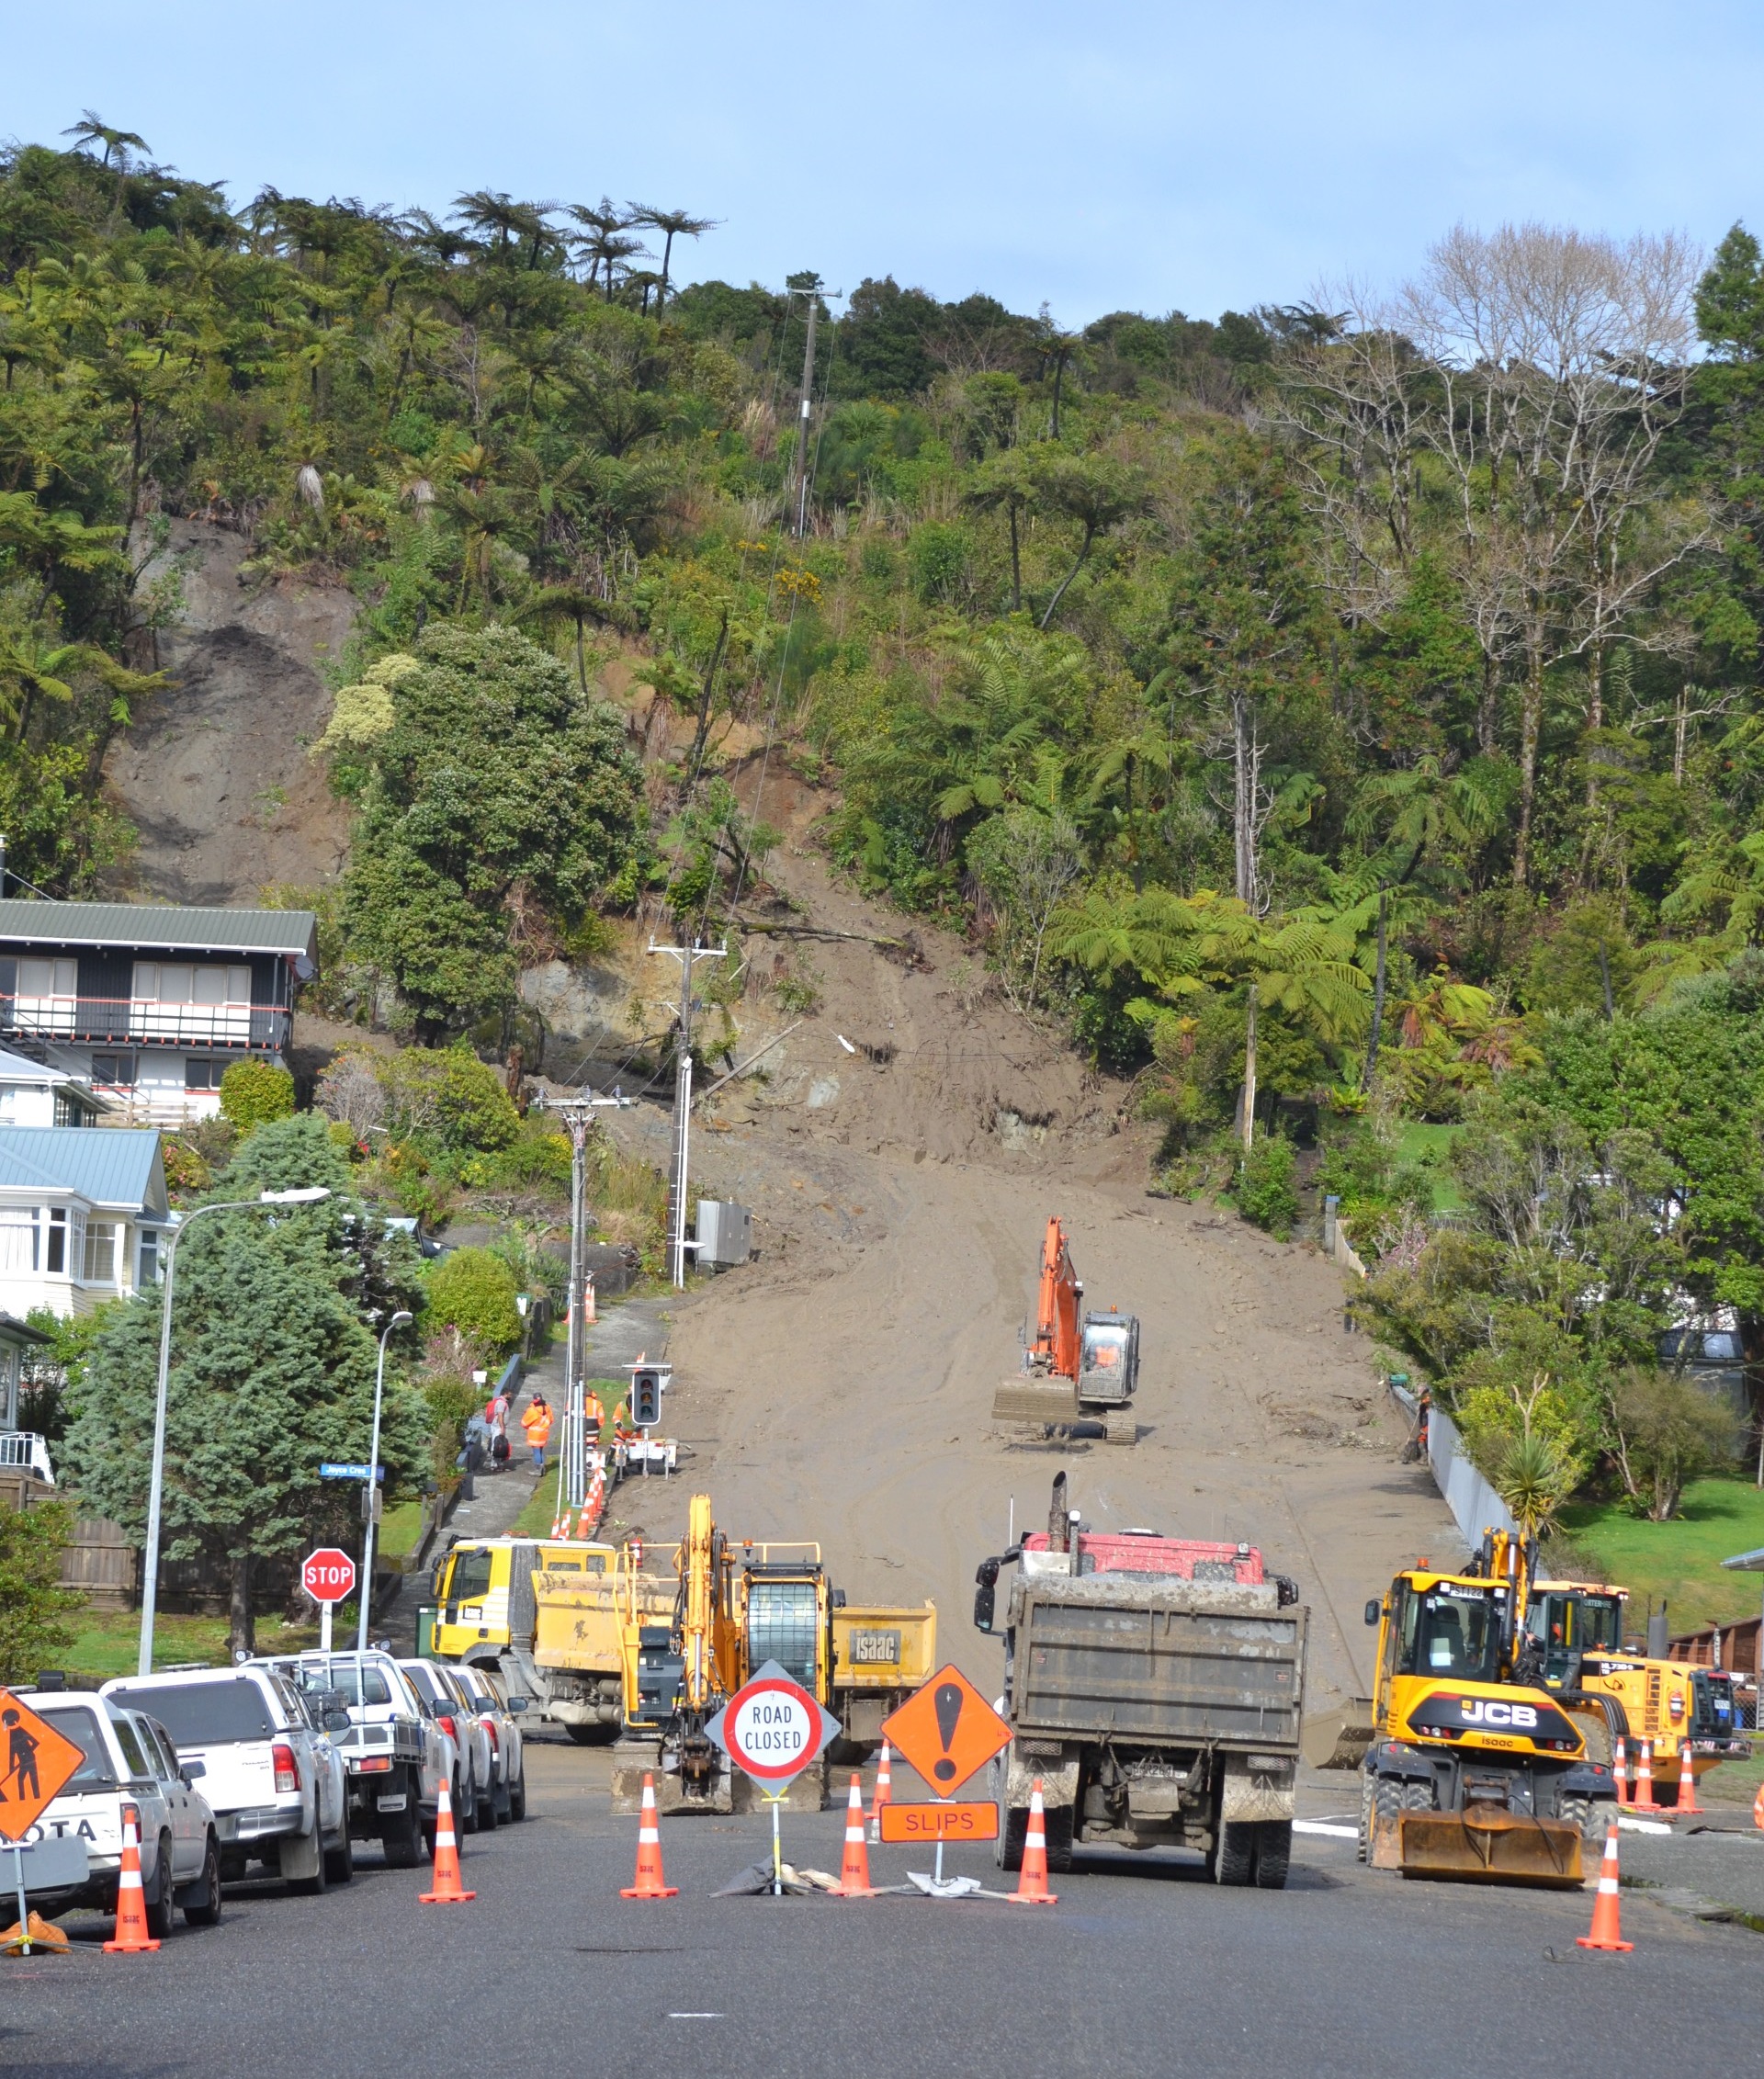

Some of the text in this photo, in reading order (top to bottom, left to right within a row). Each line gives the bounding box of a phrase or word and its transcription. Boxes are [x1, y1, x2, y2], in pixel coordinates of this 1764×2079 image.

[306, 1566, 352, 1585] STOP
[855, 1630, 895, 1660] isaac
[752, 1705, 792, 1724] ROAD
[1461, 1700, 1537, 1727] JCB
[745, 1731, 801, 1750] CLOSED
[1482, 1735, 1513, 1747] isaac
[905, 1813, 974, 1831] SLIPS
